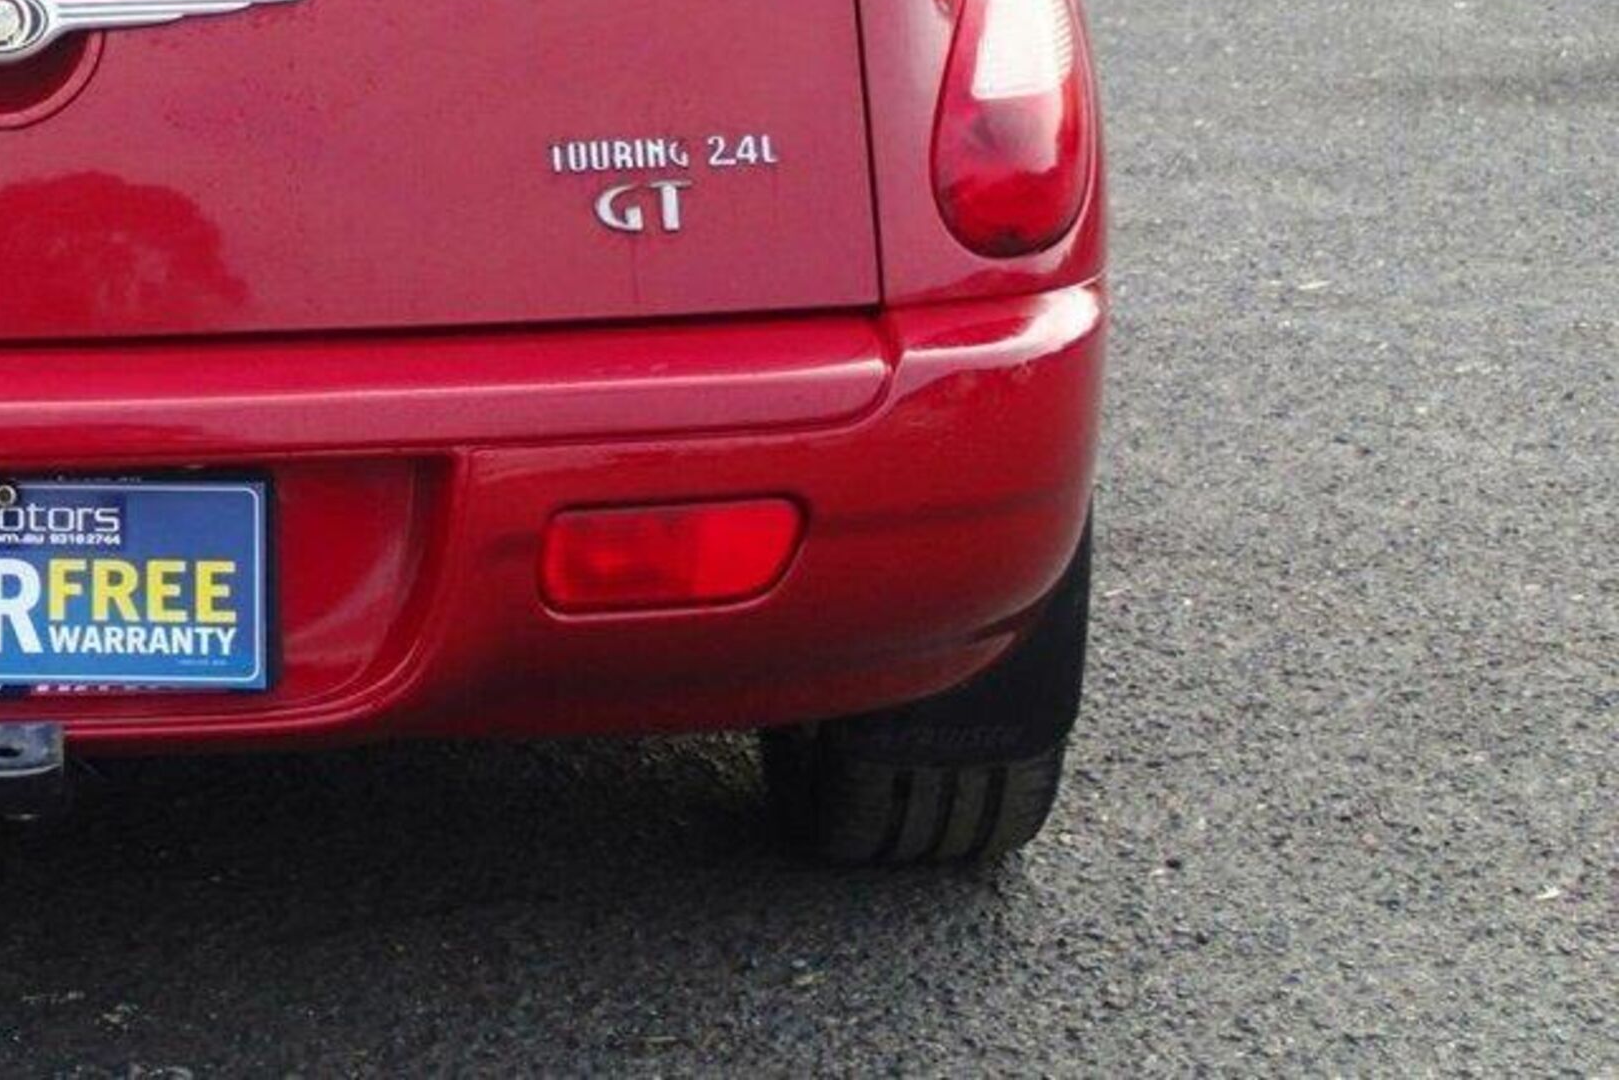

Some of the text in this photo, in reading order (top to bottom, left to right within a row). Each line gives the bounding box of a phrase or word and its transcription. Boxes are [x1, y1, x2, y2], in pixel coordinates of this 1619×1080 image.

[707, 134, 779, 167] 2.4L
[594, 179, 694, 232] GT
[48, 559, 236, 623] FREE
[49, 625, 236, 657] WARRANTY
